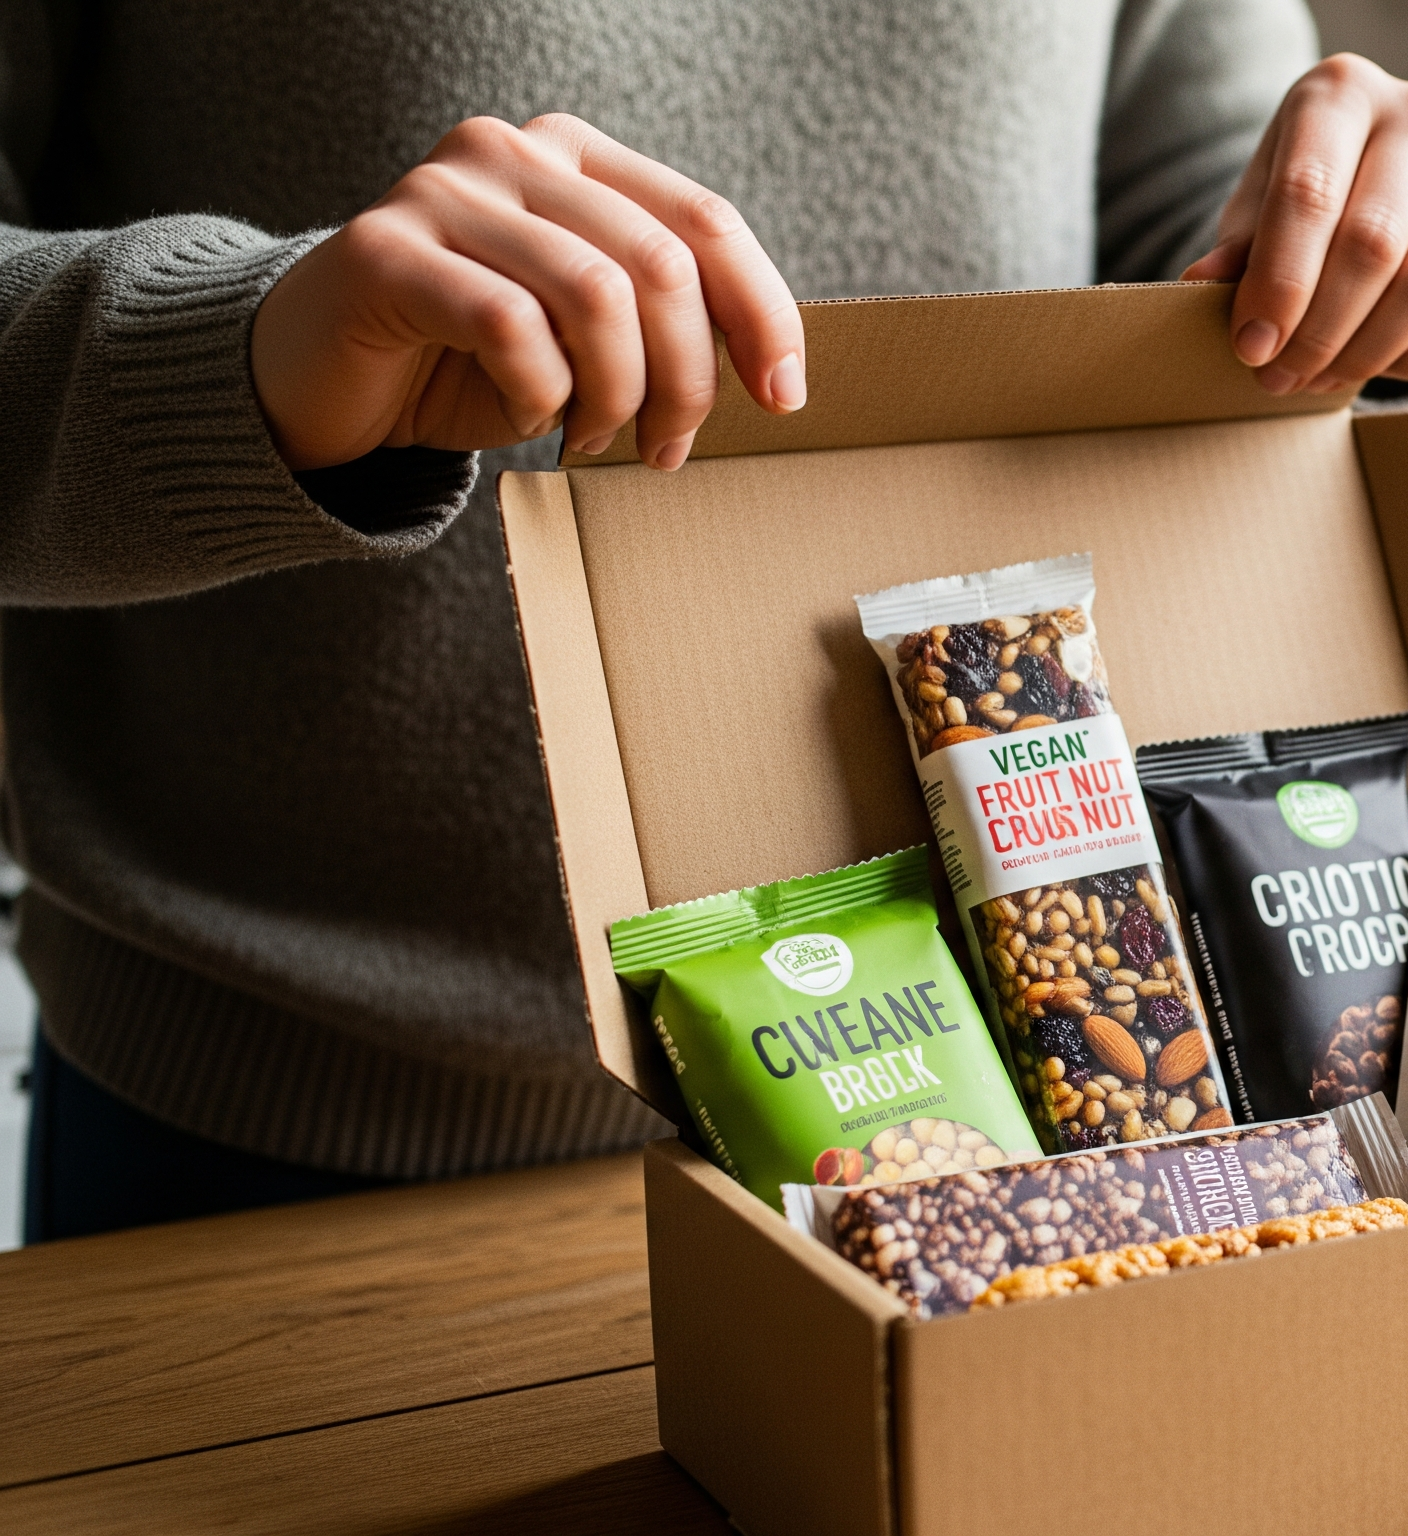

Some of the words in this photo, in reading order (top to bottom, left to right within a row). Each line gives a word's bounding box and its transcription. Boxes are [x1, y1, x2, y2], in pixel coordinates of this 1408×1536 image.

[976, 770, 1064, 817] FRUIT
[1069, 759, 1126, 799] NUT
[1082, 794, 1136, 834] NUT
